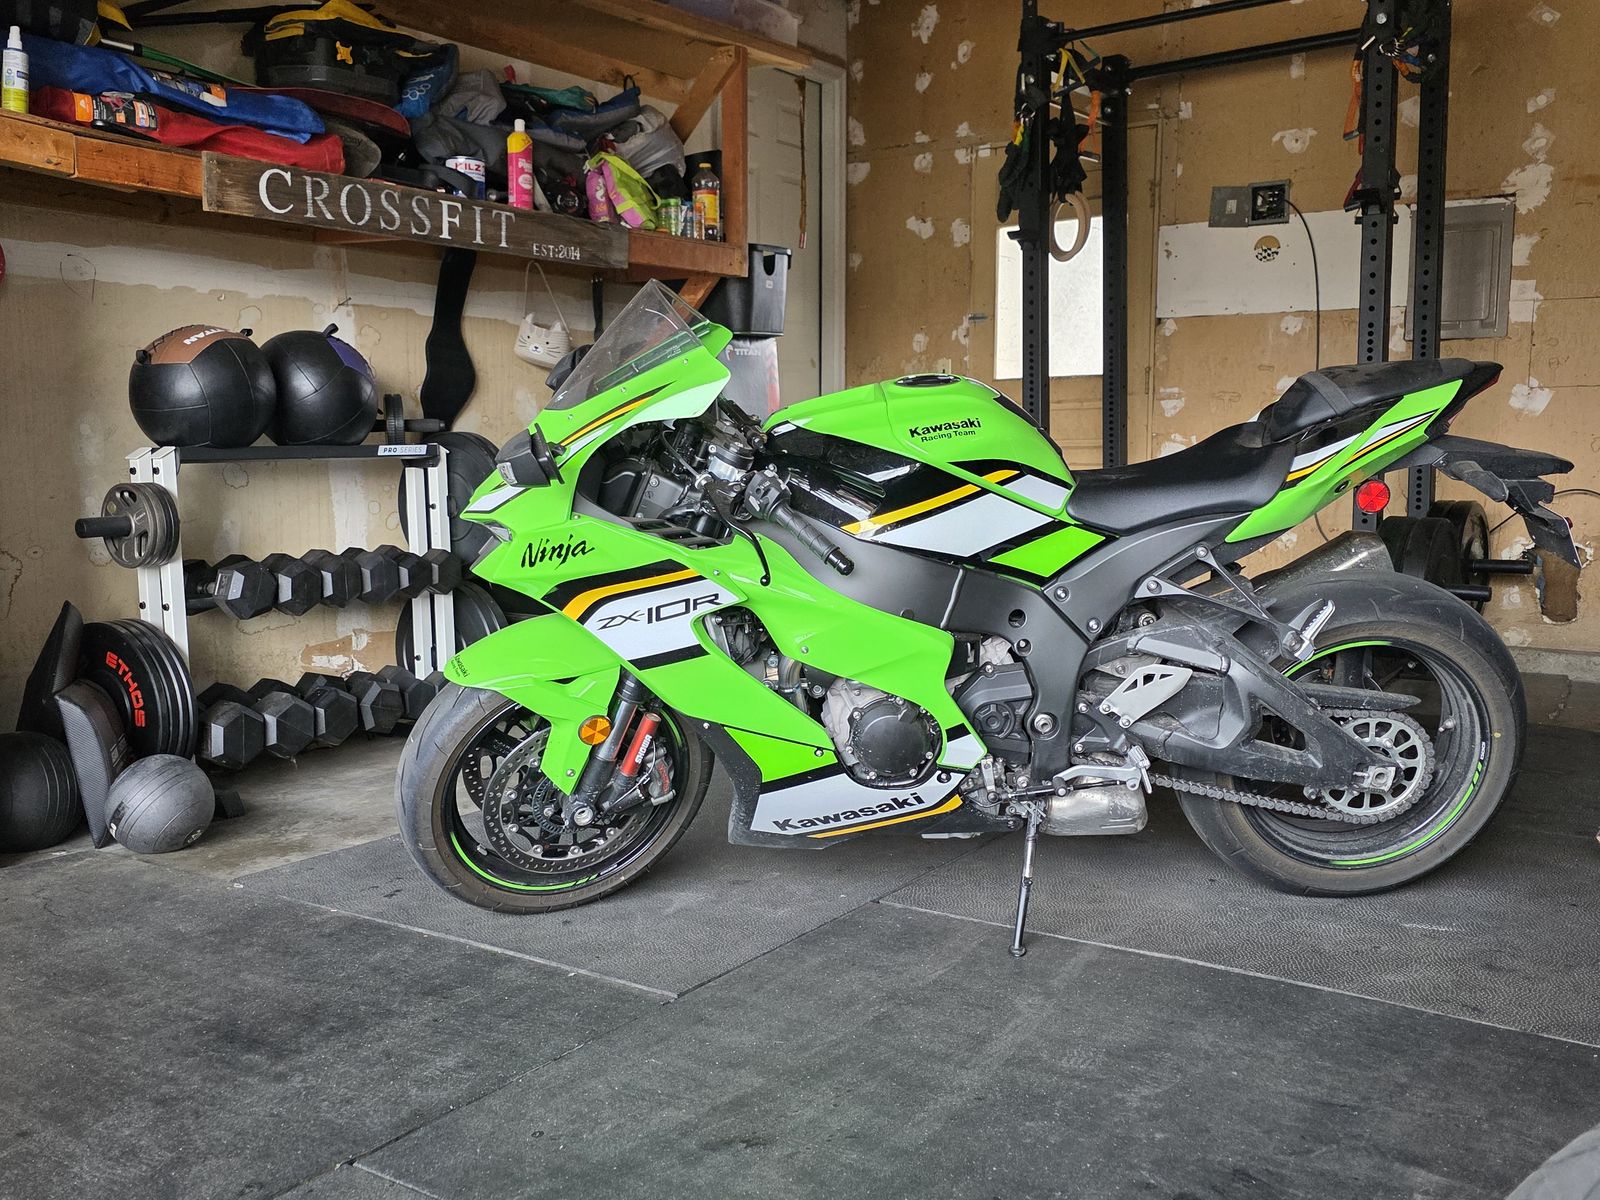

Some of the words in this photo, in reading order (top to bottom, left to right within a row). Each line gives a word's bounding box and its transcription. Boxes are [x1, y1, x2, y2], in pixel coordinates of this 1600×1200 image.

[258, 168, 516, 248] CROSSFIT
[532, 242, 581, 261] EST:2014
[734, 347, 761, 357] TITAN
[908, 417, 982, 438] Kawasaki
[921, 432, 952, 443] Racing
[953, 430, 976, 438] Team
[400, 446, 422, 454] SERIES
[521, 533, 596, 571] Ninja
[597, 592, 724, 631] ZX-10R
[105, 651, 146, 728] ETHOS
[634, 733, 653, 765] SHOWA
[772, 792, 926, 832] Kawasaki
